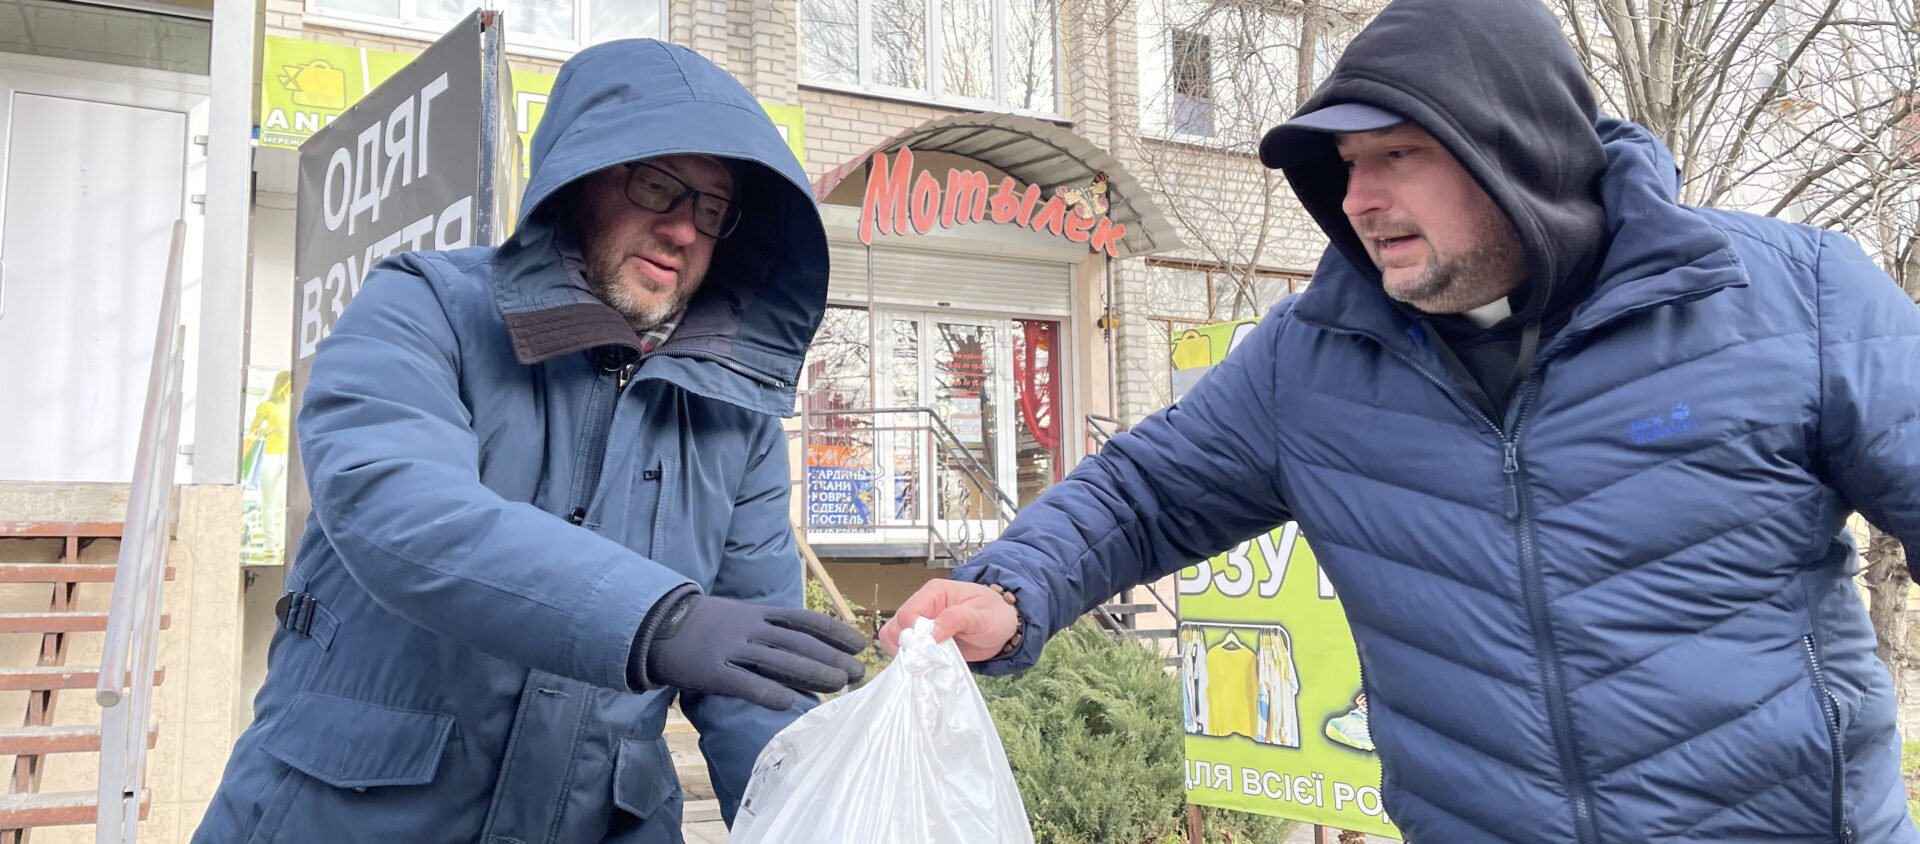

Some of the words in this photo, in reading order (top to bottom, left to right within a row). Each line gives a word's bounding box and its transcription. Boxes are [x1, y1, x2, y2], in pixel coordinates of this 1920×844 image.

[323, 72, 449, 236] ОДЯГ
[858, 146, 1126, 258] Мотылек
[811, 481, 852, 491] ТКАНИ
[811, 491, 852, 502] КОВРЫ
[1179, 520, 1338, 599] ВЗУ
[1185, 759, 1233, 791] ДЛЯ
[1241, 767, 1324, 807] ВСІЄЇ
[1333, 781, 1390, 824] РО
